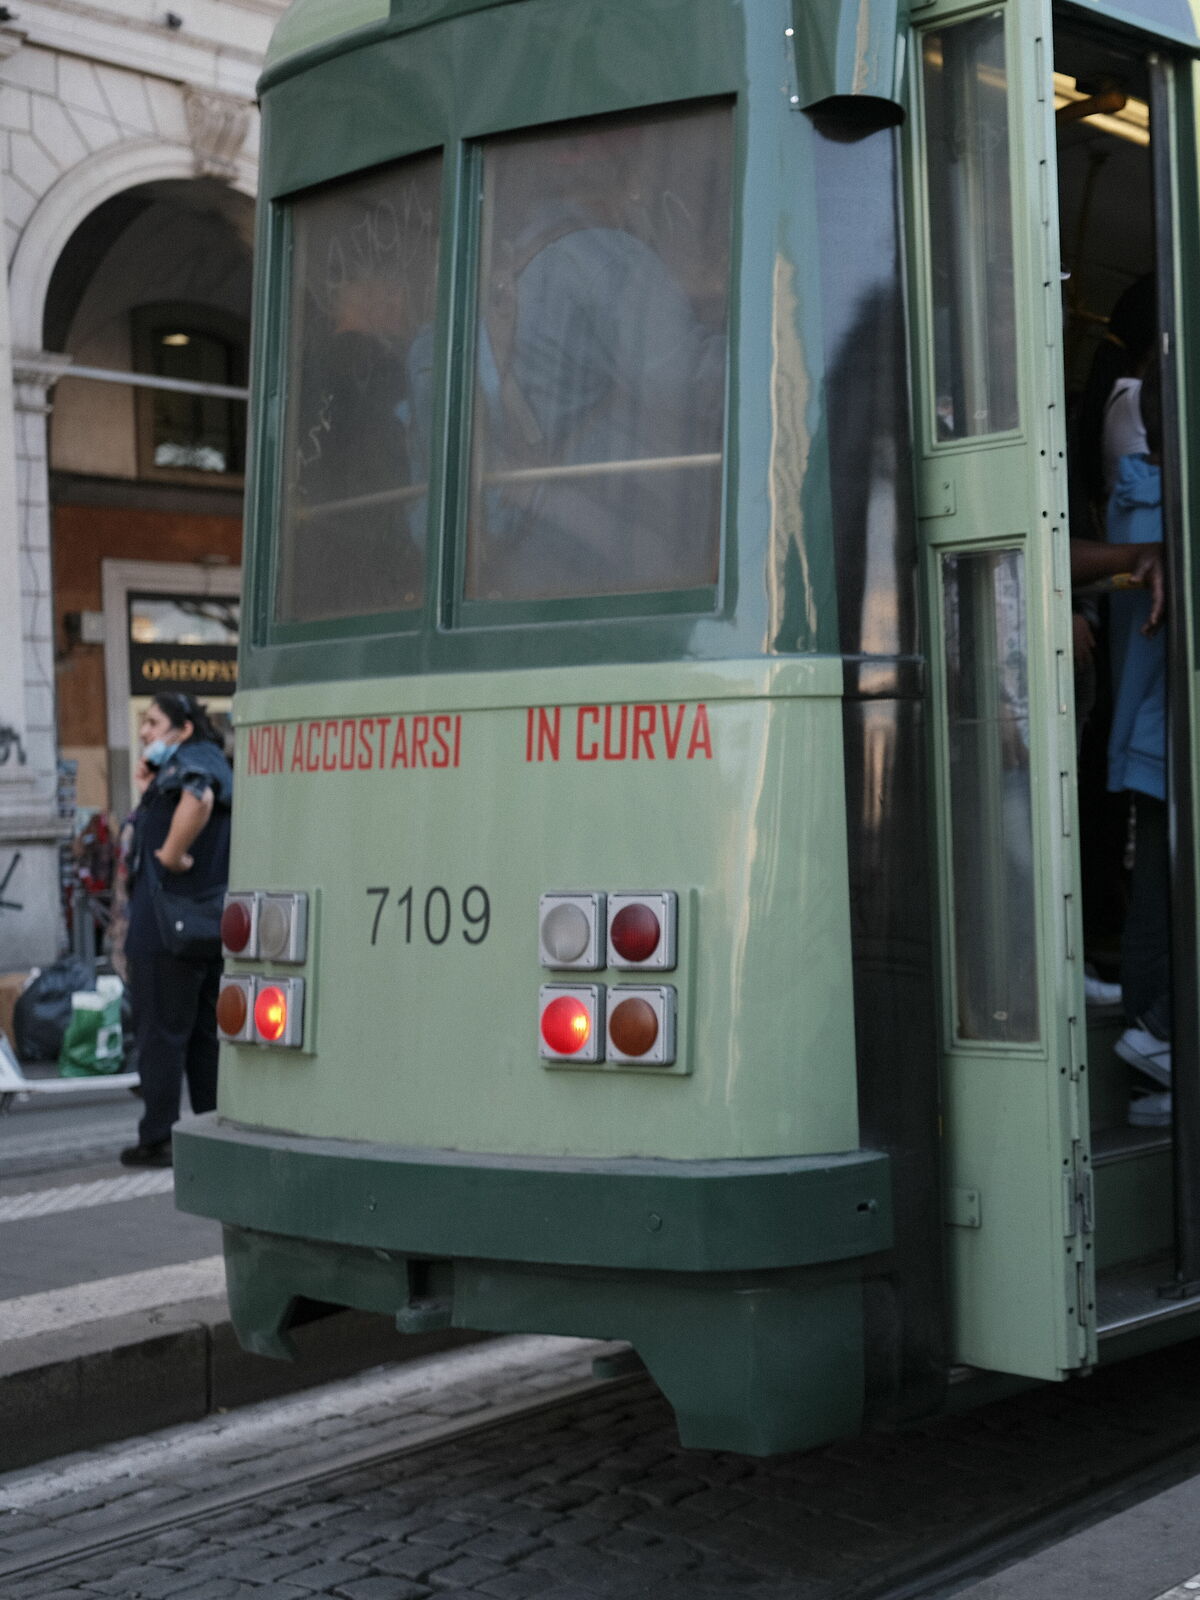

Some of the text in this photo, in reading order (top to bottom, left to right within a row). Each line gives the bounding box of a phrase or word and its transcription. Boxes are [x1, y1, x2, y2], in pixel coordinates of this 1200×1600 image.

[248, 704, 712, 775] NON ACCOSTARSI IN CURVA
[366, 884, 491, 946] 7109
